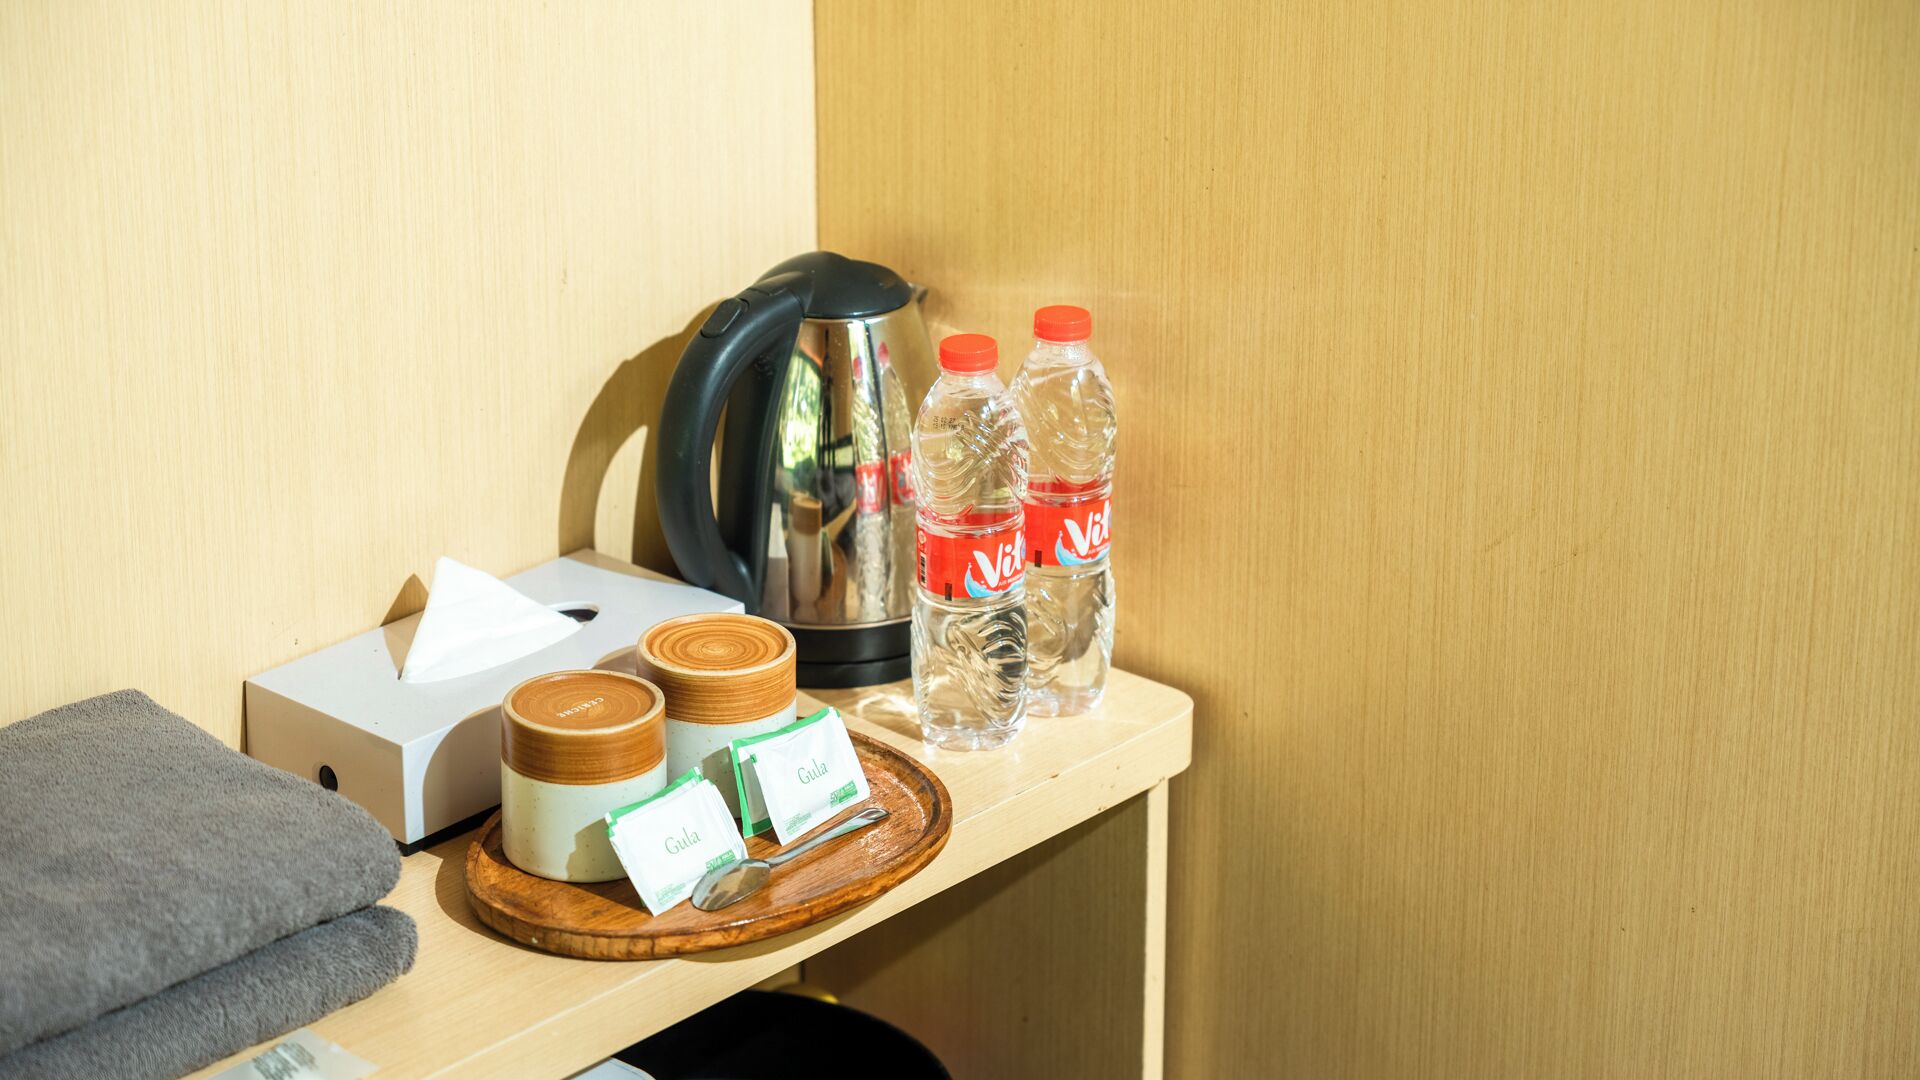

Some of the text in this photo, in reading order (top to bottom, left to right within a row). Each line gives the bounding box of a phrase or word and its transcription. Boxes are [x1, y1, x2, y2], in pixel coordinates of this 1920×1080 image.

[972, 530, 1025, 588] Vit
[797, 758, 829, 785] Gula
[664, 827, 702, 855] Gula
